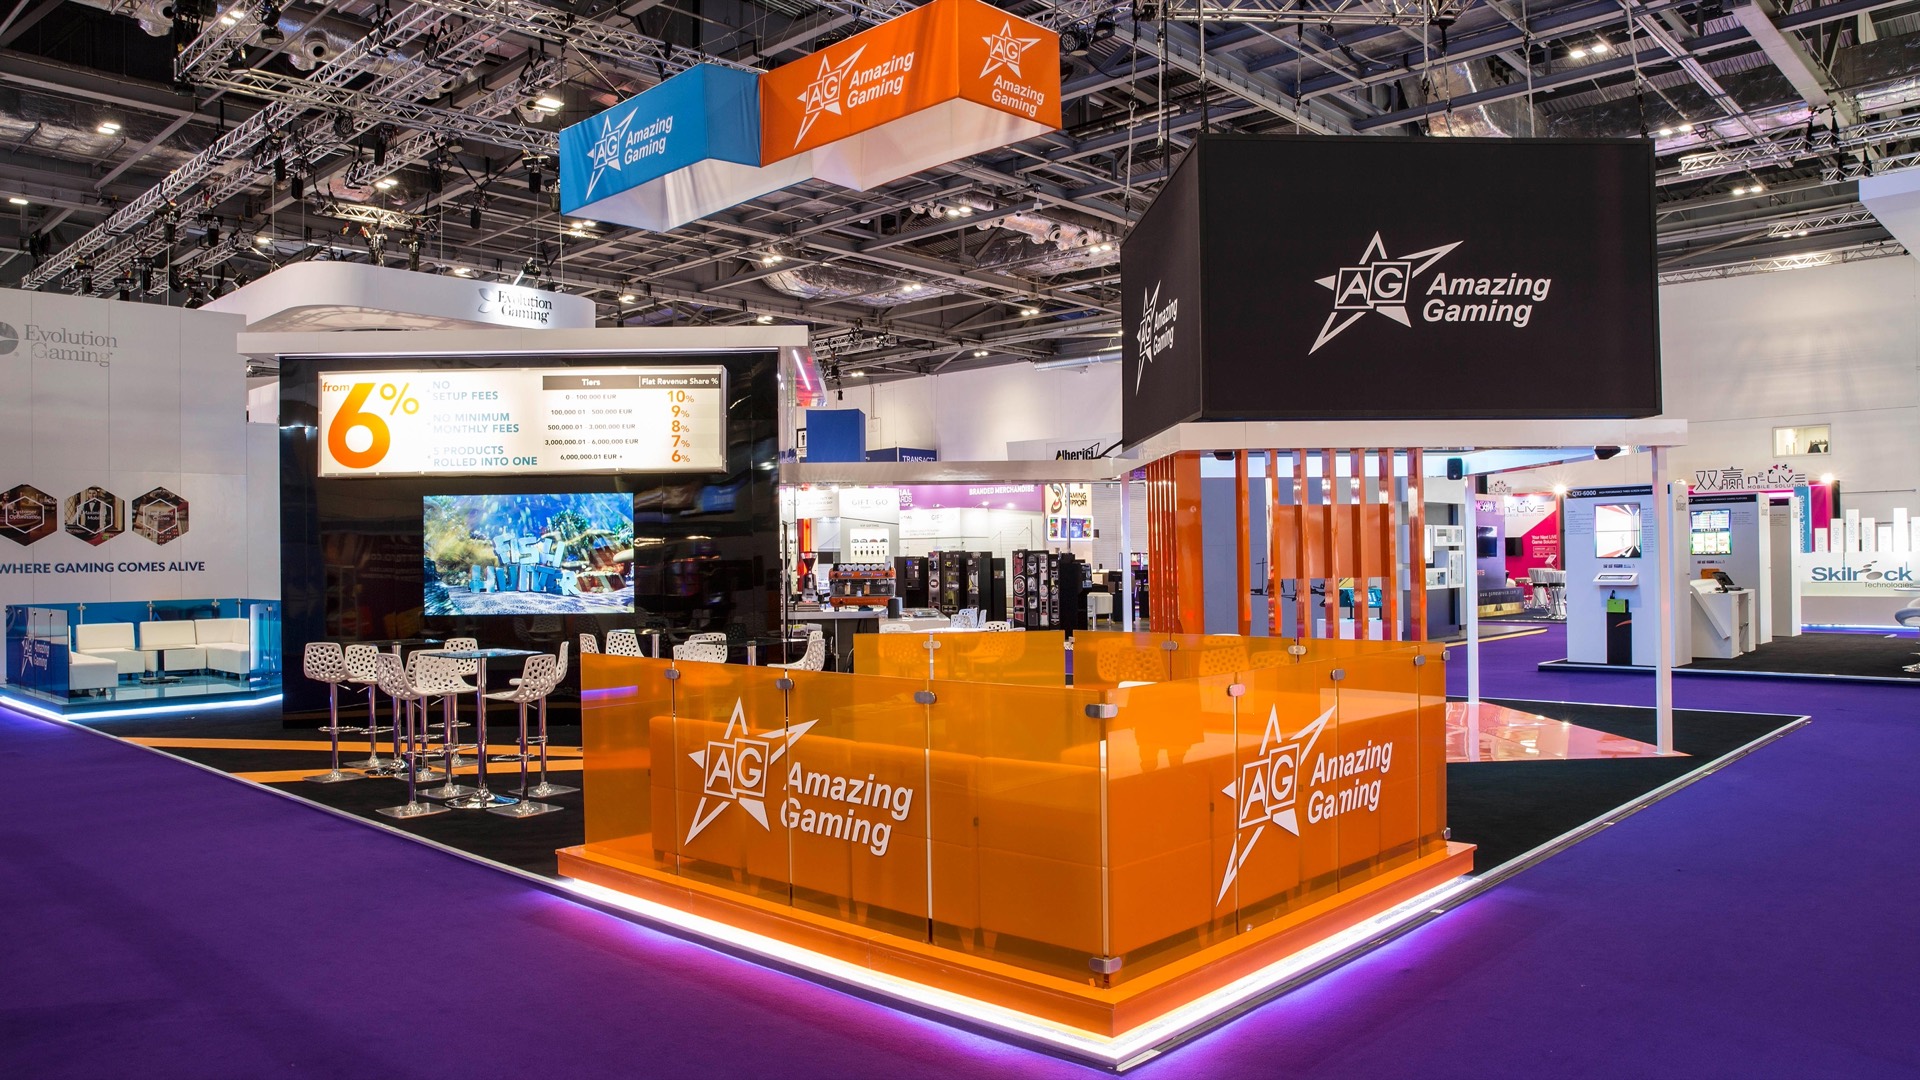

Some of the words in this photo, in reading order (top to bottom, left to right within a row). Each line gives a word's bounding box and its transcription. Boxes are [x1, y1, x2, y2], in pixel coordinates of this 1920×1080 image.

[991, 40, 1018, 60] AG
[848, 51, 915, 90] Amazing
[807, 76, 838, 111] AG
[846, 75, 904, 108] Gaming
[991, 88, 1038, 118] Gaming
[993, 74, 1045, 105] Amazing
[625, 115, 673, 148] Amazing
[595, 135, 618, 166] AG
[624, 136, 667, 165] Gaming
[1338, 267, 1403, 304] AG
[1426, 272, 1552, 302] Amazing
[501, 304, 550, 324] Gaming
[1153, 298, 1178, 334] Amazing
[1422, 298, 1533, 328] Gaming
[24, 324, 118, 348] Evolution
[1153, 326, 1175, 356] Gaming
[31, 341, 110, 368] Gaming
[322, 381, 350, 392] from
[433, 381, 450, 390] NO
[581, 378, 601, 386] Tiers
[641, 378, 656, 386] Flat
[689, 377, 709, 385] Share
[433, 392, 468, 401] SETUP
[472, 391, 499, 400] FEES
[667, 390, 695, 403] 10%
[433, 413, 452, 422] NO
[455, 412, 510, 422] MINIMUM
[671, 405, 690, 418] 9%
[433, 424, 488, 433] MONTHLY
[492, 423, 520, 433] FEES
[671, 420, 690, 433] 8%
[443, 446, 504, 455] PRODUCTS
[671, 435, 691, 448] 7%
[434, 458, 477, 467] ROLLED
[481, 457, 509, 466] INTO
[513, 457, 538, 466] ONE
[671, 449, 691, 463] 6%
[969, 486, 995, 496] BRANDED
[995, 484, 1035, 495] MERCHANDISE
[0, 563, 51, 574] WHERE
[54, 562, 115, 573] GAMING
[117, 562, 166, 573] COMES
[168, 561, 206, 572] ALIVE
[1864, 581, 1914, 589] Technologies
[707, 747, 763, 788] AG
[1309, 739, 1393, 787] Amazing
[783, 761, 914, 821] Amazing
[1241, 754, 1294, 820] AG
[1307, 779, 1382, 825] Gaming
[780, 797, 892, 857] Gaming
